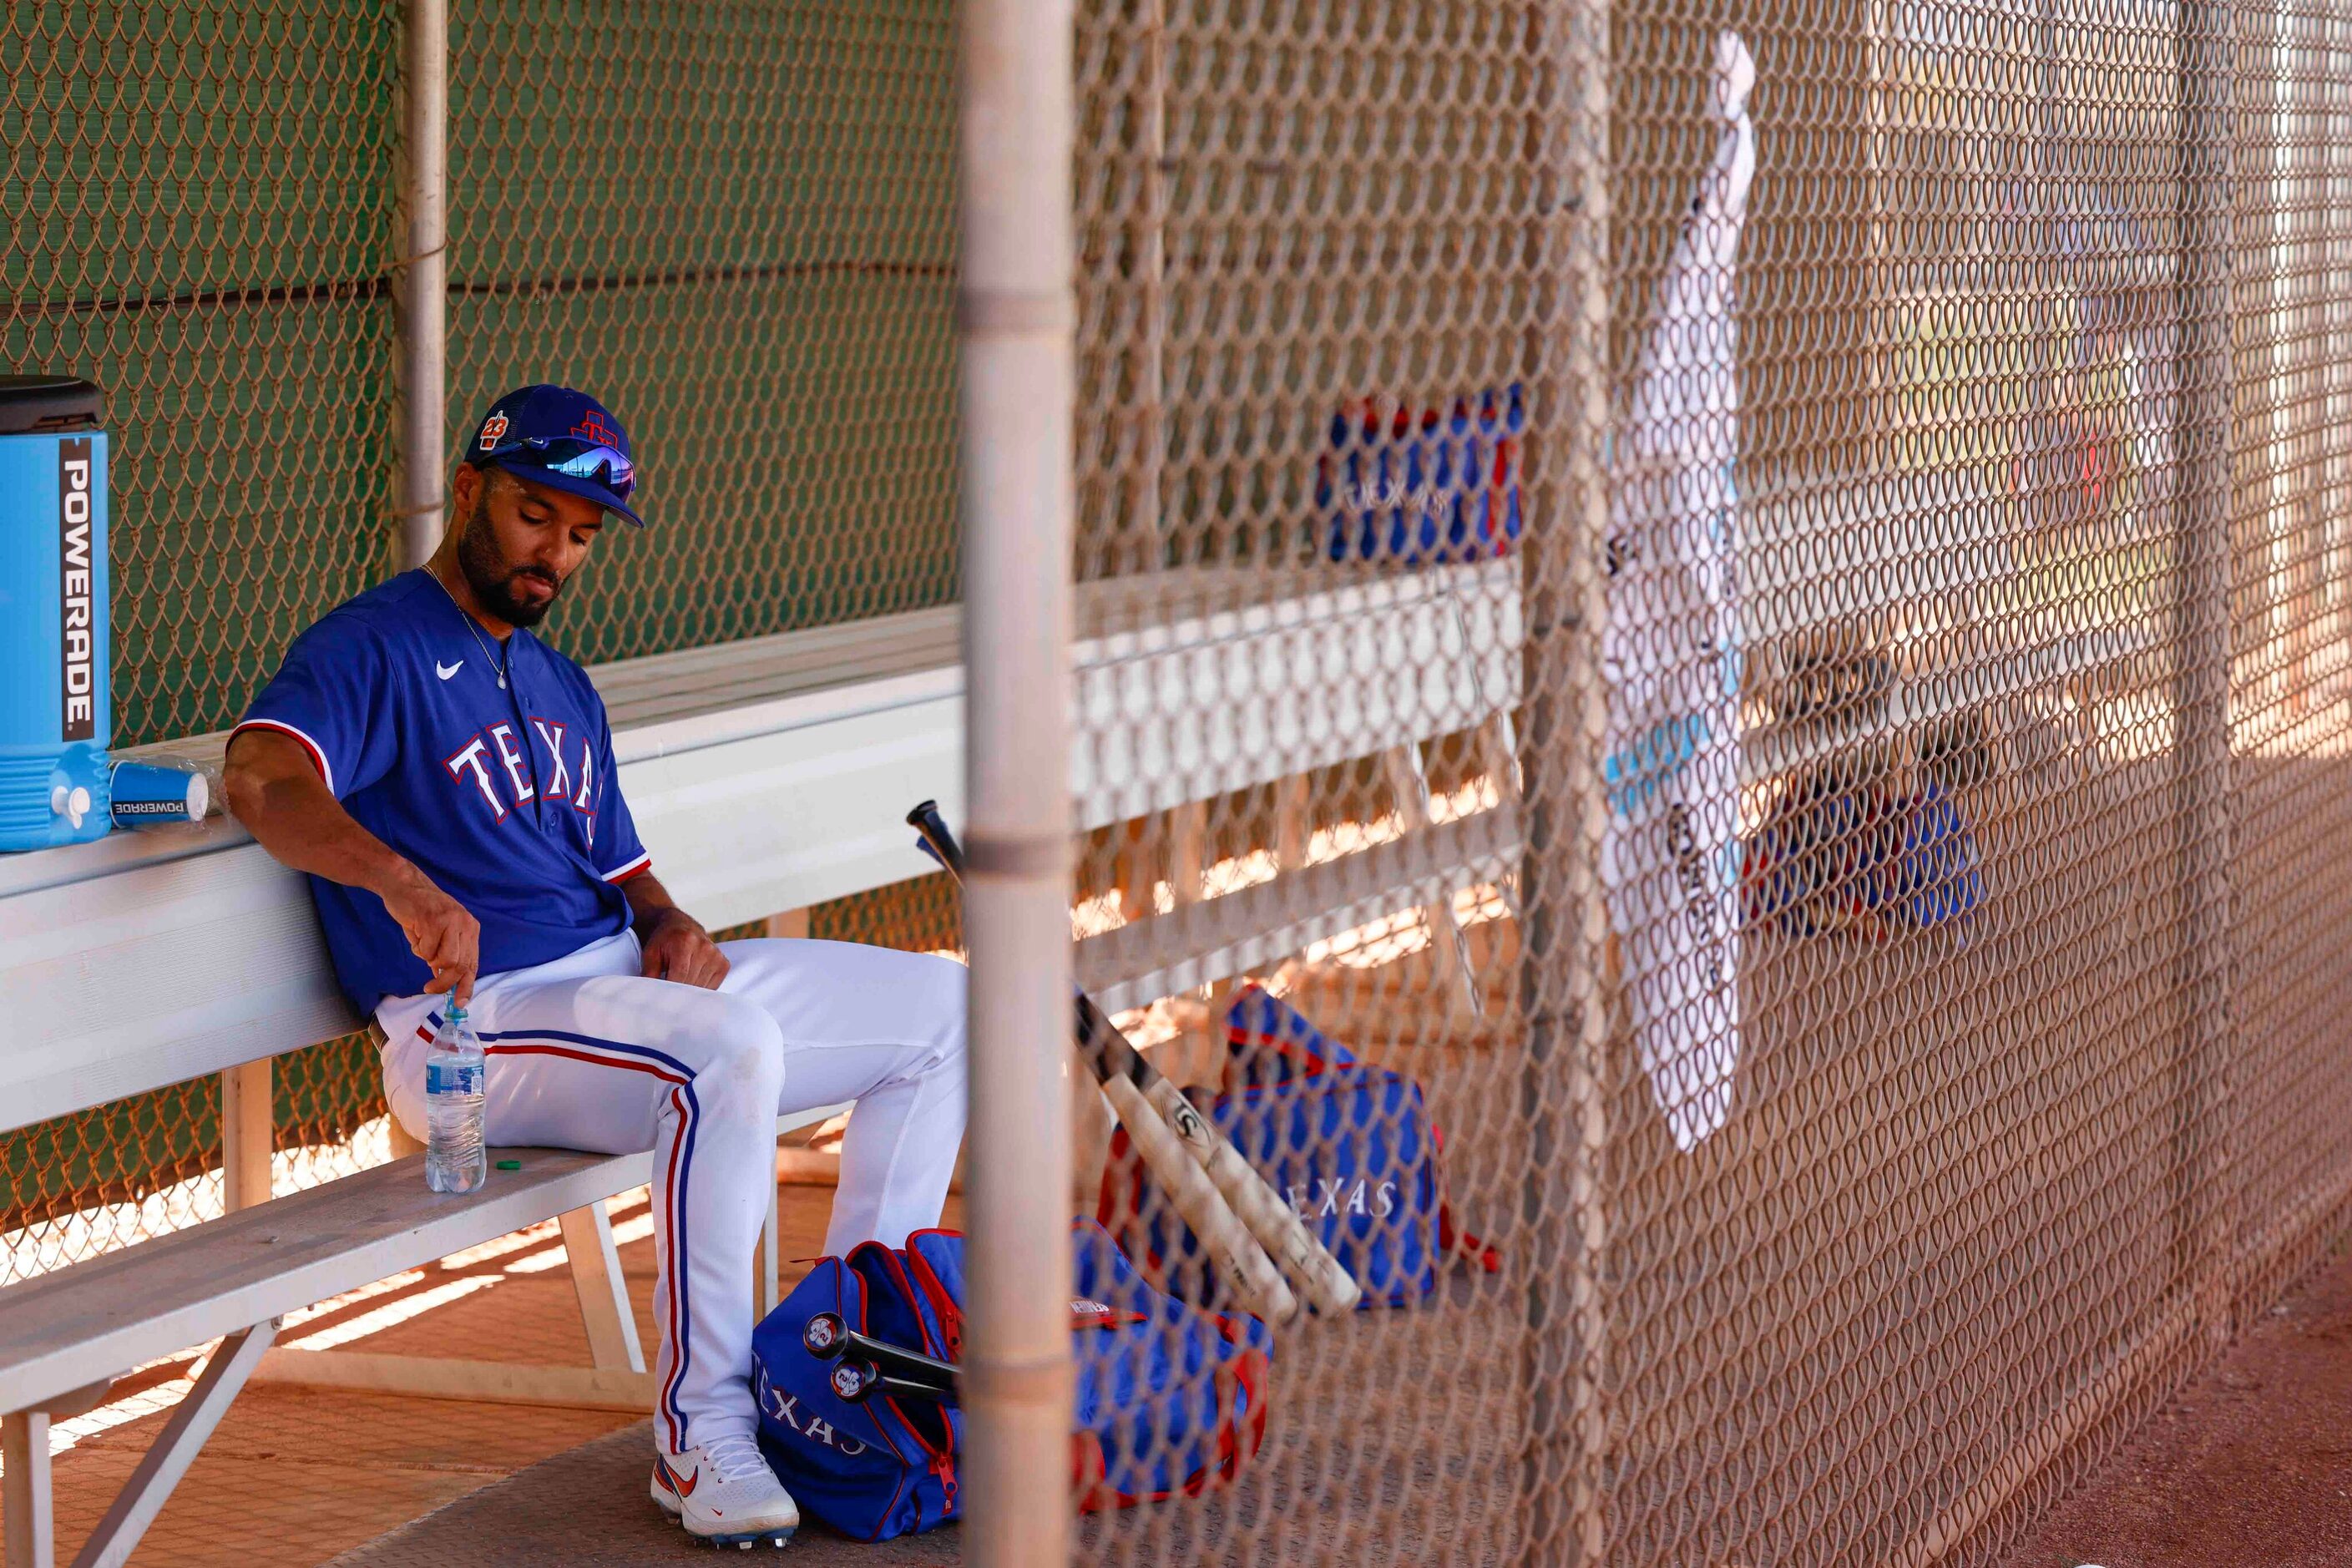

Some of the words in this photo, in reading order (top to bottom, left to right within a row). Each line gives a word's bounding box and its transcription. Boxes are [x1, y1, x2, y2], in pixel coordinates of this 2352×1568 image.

[64, 459, 91, 724] POWERADE
[114, 802, 185, 813] POWERADE
[442, 716, 604, 851] TEXA
